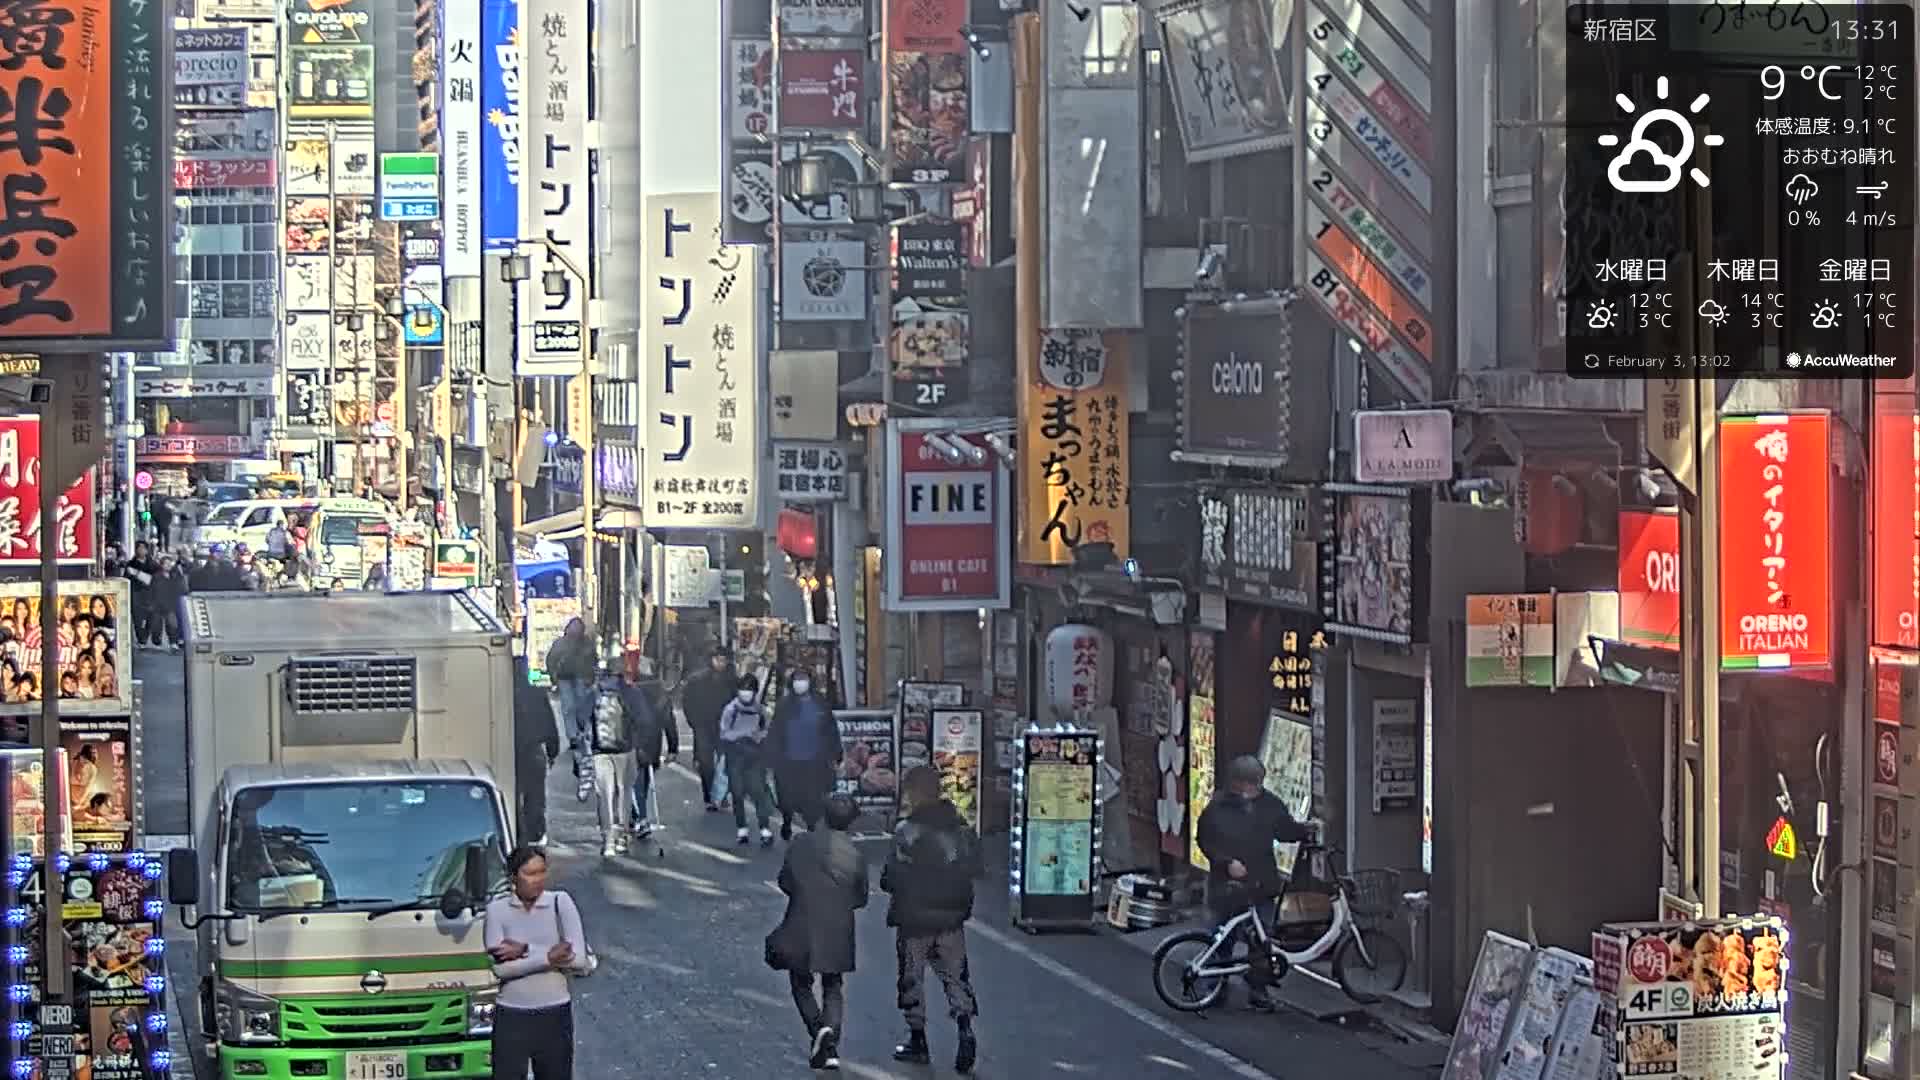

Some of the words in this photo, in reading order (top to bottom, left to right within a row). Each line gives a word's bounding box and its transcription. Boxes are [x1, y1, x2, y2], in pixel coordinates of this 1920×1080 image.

[1313, 21, 1334, 40] 5
[449, 38, 473, 103] 火鍋
[1314, 74, 1333, 89] 4
[830, 58, 858, 118] 牛門
[1314, 121, 1333, 141] 3
[1313, 171, 1333, 192] 2
[1316, 221, 1331, 239] 1
[1312, 268, 1339, 297] B1
[660, 208, 691, 461] トントン
[714, 324, 737, 443] 焼とん酒場
[1212, 352, 1262, 393] celona
[916, 383, 946, 404] 2F
[1394, 425, 1413, 449] A
[1041, 396, 1083, 547] まっちゃん
[911, 484, 986, 512] FINE
[1754, 430, 1788, 603] 俺のイタリアン
[910, 559, 953, 574] ONLINE
[957, 559, 988, 573] CAFE
[1740, 614, 1808, 633] ORENO
[1740, 633, 1808, 650] ITALIAN
[1629, 990, 1663, 1012] 4F
[361, 1063, 404, 1079] 11-90
